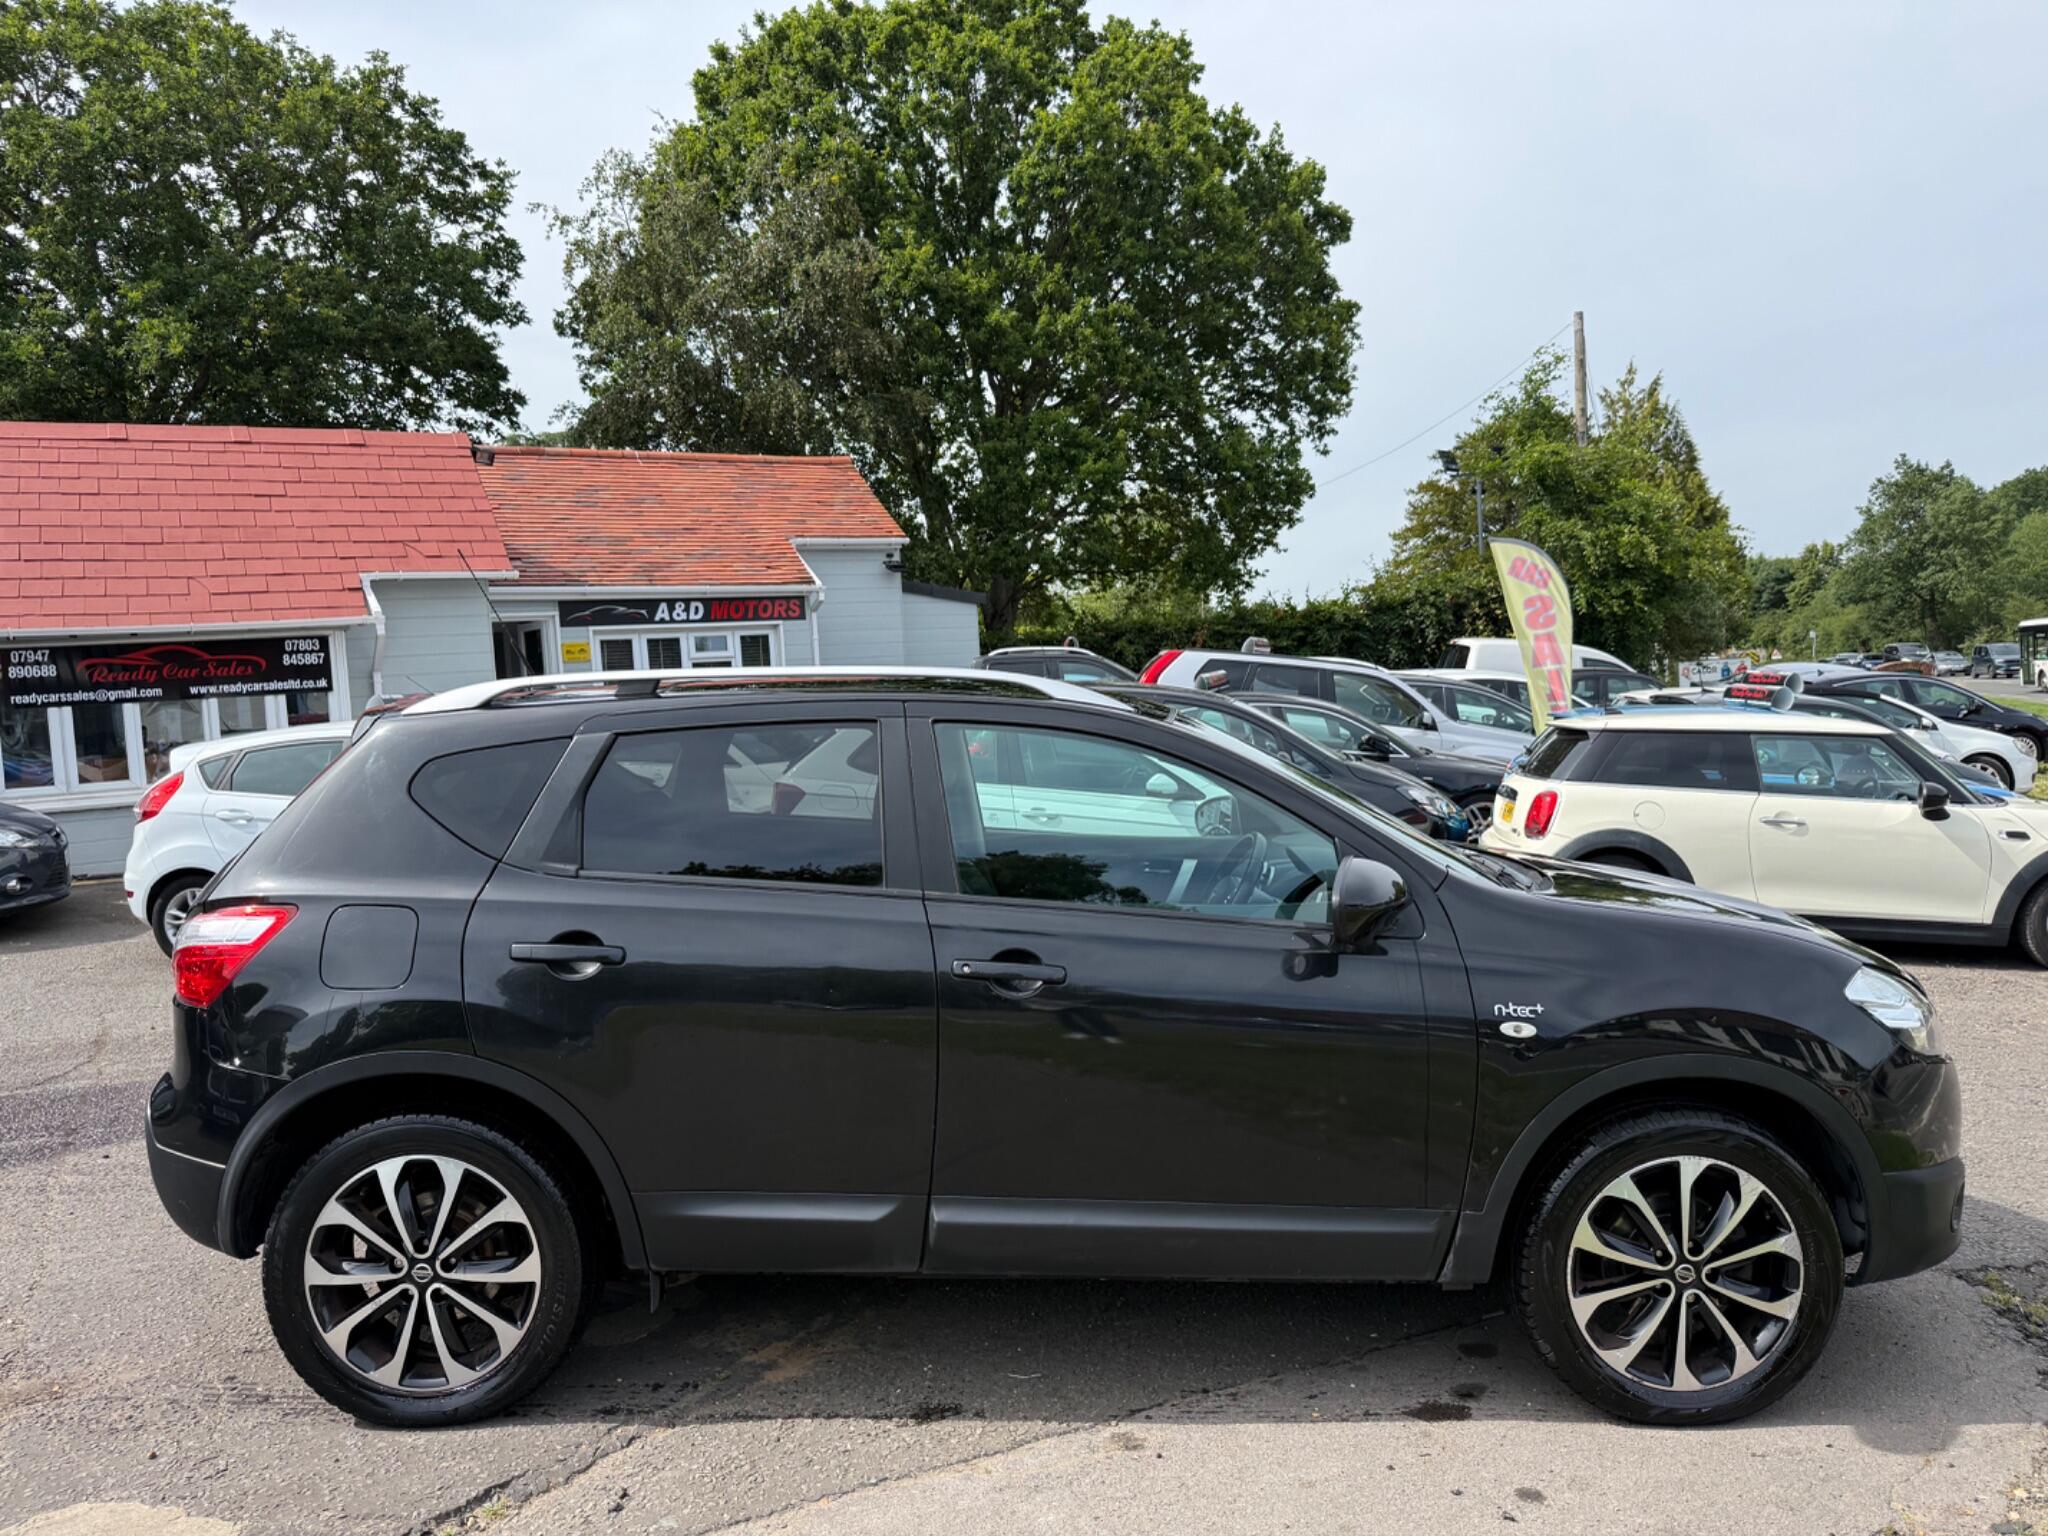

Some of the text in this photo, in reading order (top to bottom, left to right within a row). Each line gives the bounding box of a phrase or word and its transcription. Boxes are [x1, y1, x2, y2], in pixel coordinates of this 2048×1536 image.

[654, 599, 801, 622] A&D MOTORS
[284, 639, 320, 652] 07803
[10, 650, 50, 663] 07947
[282, 653, 325, 667] 845867
[8, 664, 57, 679] 890688
[87, 660, 254, 683] Ready Car Sales
[189, 677, 328, 695] www.readycarsalesltd.co.uk
[10, 687, 163, 705] readycarssales@gmail.com
